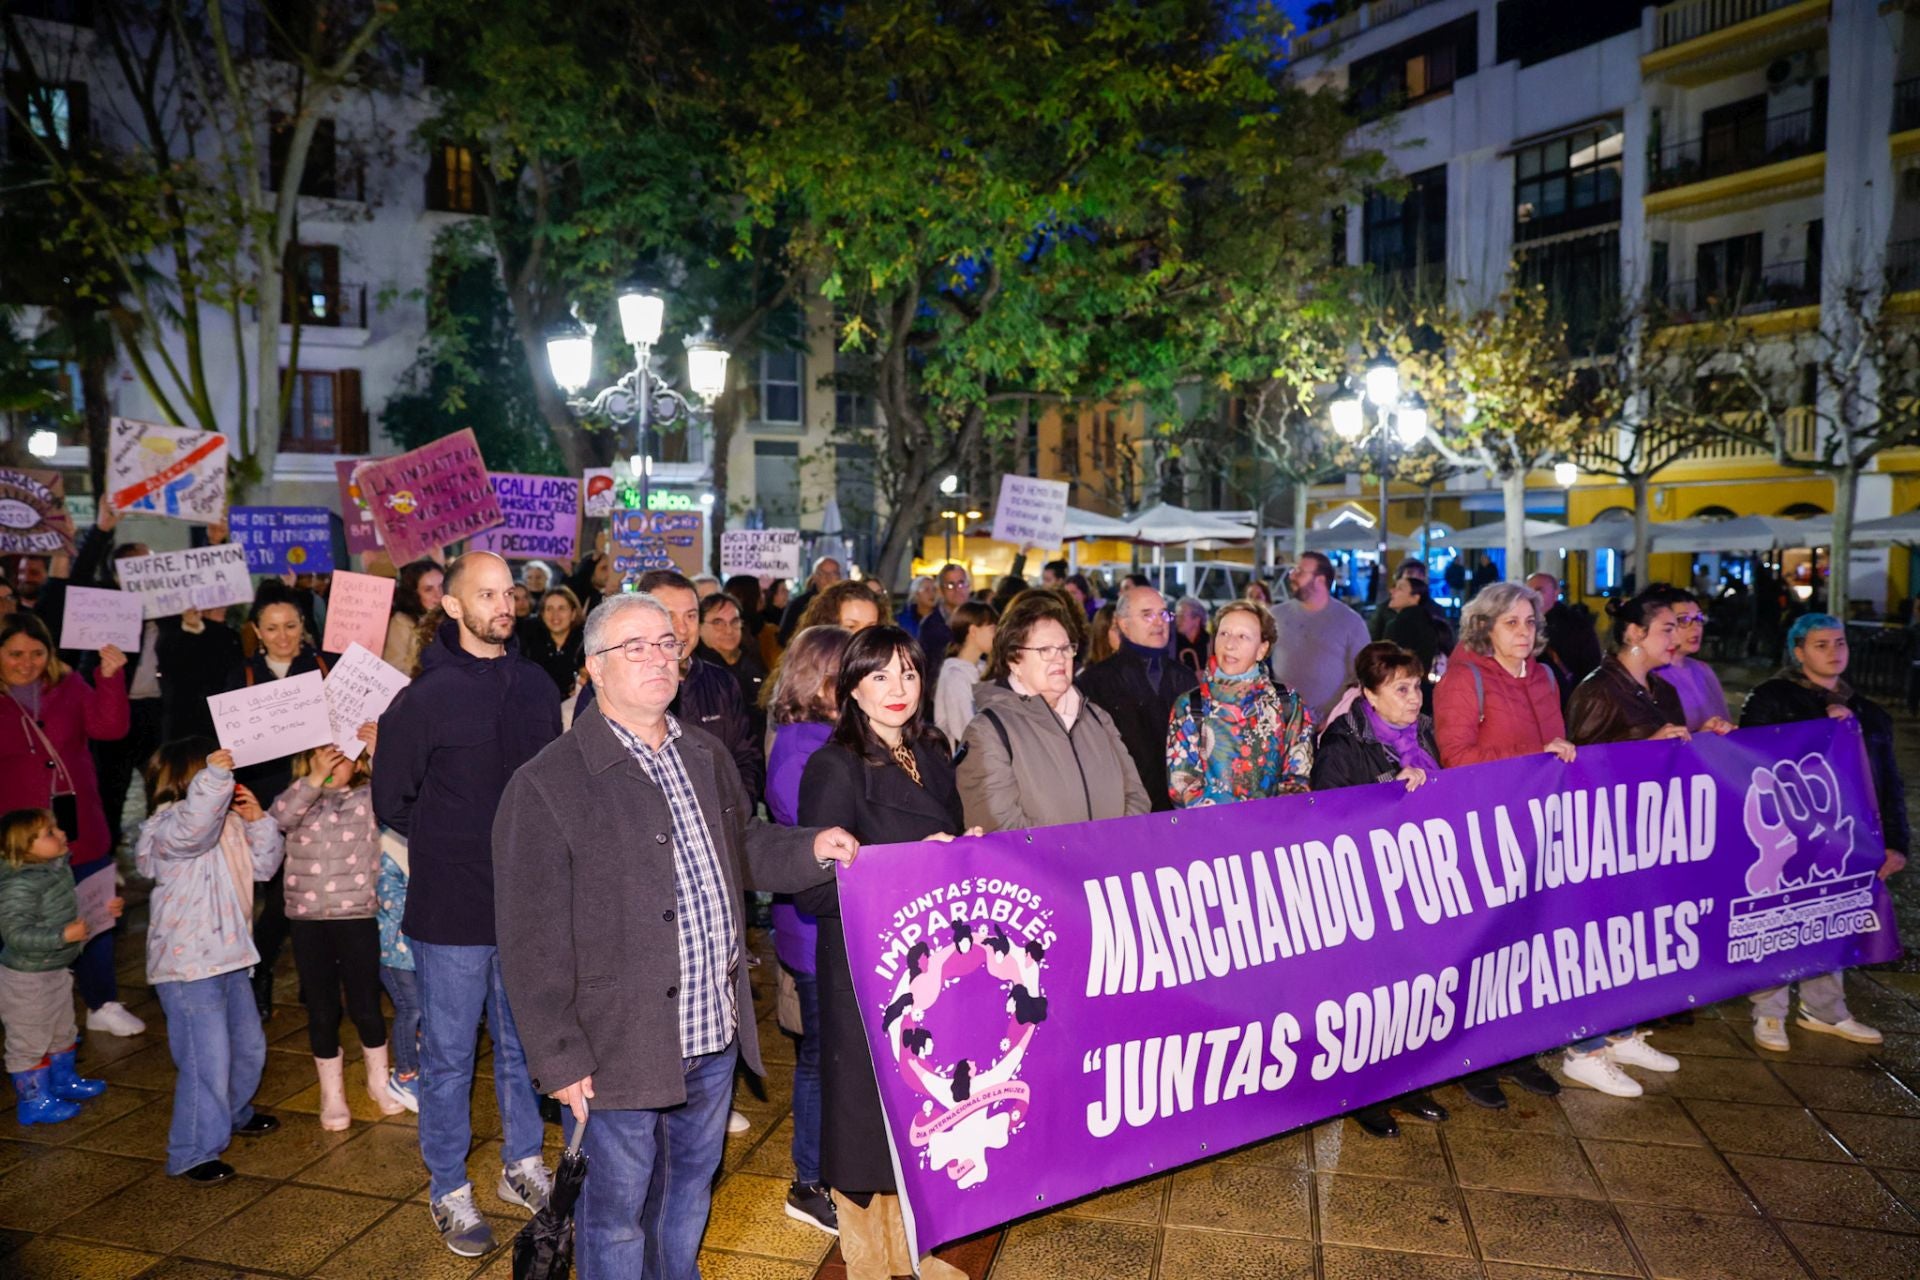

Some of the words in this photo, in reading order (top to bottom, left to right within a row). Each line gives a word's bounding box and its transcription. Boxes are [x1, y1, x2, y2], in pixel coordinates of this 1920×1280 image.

[371, 476, 395, 497] LA
[401, 446, 479, 484] INDUSTRIA
[421, 467, 481, 500] MILITAR
[498, 477, 578, 502] CALLADAS
[385, 516, 408, 533] ES
[415, 484, 497, 522] VIOLENCIA
[419, 509, 502, 547] PATRIARCAL
[612, 511, 648, 541] NO
[486, 533, 496, 550] Y
[501, 534, 575, 556] DECIDIDAS!
[215, 570, 227, 583] A
[358, 652, 384, 671] SIN
[218, 700, 240, 717] La
[247, 684, 301, 707] igualdad
[333, 671, 373, 697] HARRY
[225, 720, 241, 731] no
[248, 715, 263, 725] es
[268, 707, 289, 718] una
[232, 738, 247, 748] es
[252, 732, 265, 741] un
[1083, 834, 1376, 998] MARCHANDO
[1368, 817, 1473, 932] POR
[1466, 804, 1528, 908] LA
[1528, 773, 1717, 892] IGUALDAD
[892, 879, 972, 928] JUNTAS
[975, 877, 1043, 910] SOMOS
[1730, 914, 1782, 935] Federación
[1782, 911, 1795, 923] de
[1858, 891, 1872, 905] de
[874, 897, 1057, 981] IMPARABLES
[1730, 928, 1798, 960] mujeres
[1802, 920, 1823, 942] de
[1827, 911, 1876, 936] Lorca
[1310, 965, 1459, 1082] SOMOS
[928, 1097, 981, 1135] INTERNACIONAL
[982, 1092, 992, 1100] DE
[992, 1088, 1003, 1096] LA
[1003, 1087, 1026, 1095] MUJER
[515, 1183, 531, 1200] N
